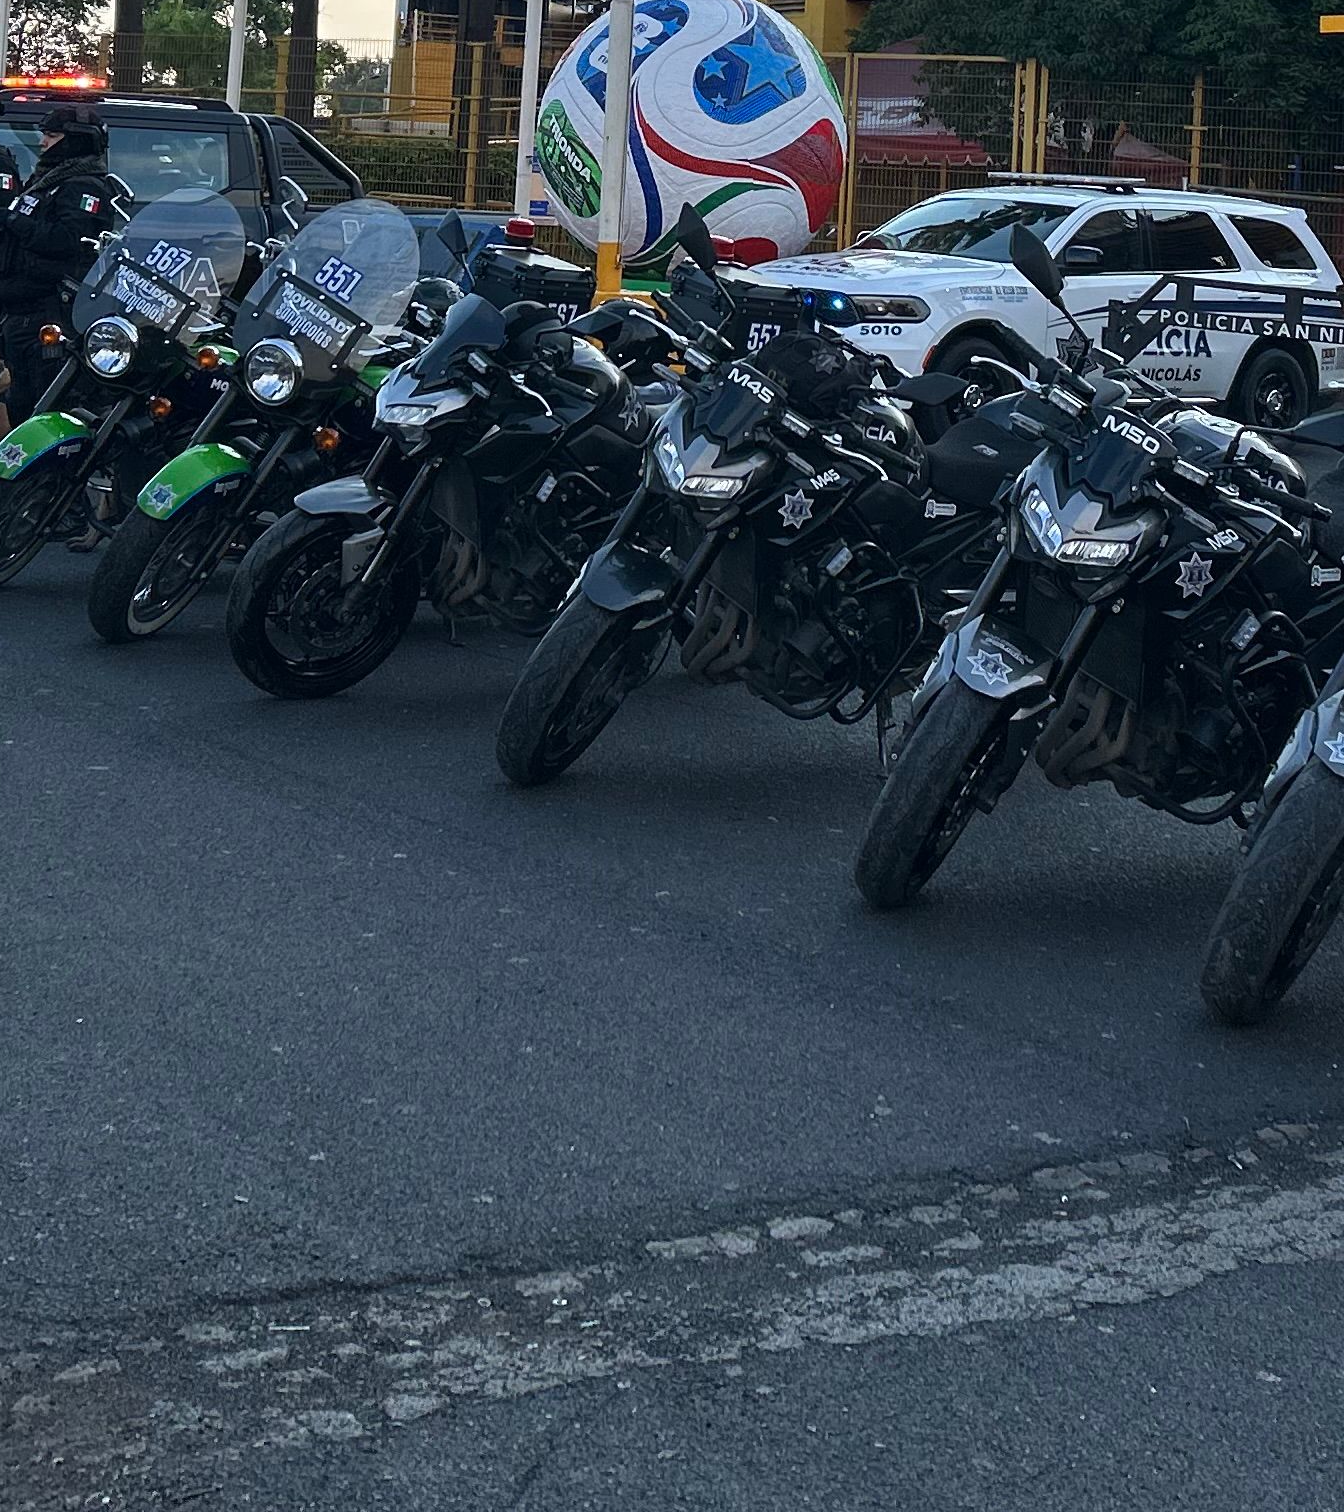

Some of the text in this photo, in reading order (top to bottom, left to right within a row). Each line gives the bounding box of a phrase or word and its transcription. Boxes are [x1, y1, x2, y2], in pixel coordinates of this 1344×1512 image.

[550, 113, 593, 183] TRIONDA
[145, 239, 192, 278] 567
[119, 264, 178, 310] MOVILIDAD
[314, 257, 362, 302] 551
[282, 288, 346, 334] MOVILIDAD
[859, 324, 902, 336] 5010
[1160, 309, 1255, 335] POLICIA
[1263, 318, 1310, 340] SAN
[728, 367, 775, 404] M45
[1142, 364, 1202, 381] NICOLÁS
[1101, 414, 1161, 455] M50
[809, 468, 841, 490] M45
[1206, 528, 1239, 550] M50
